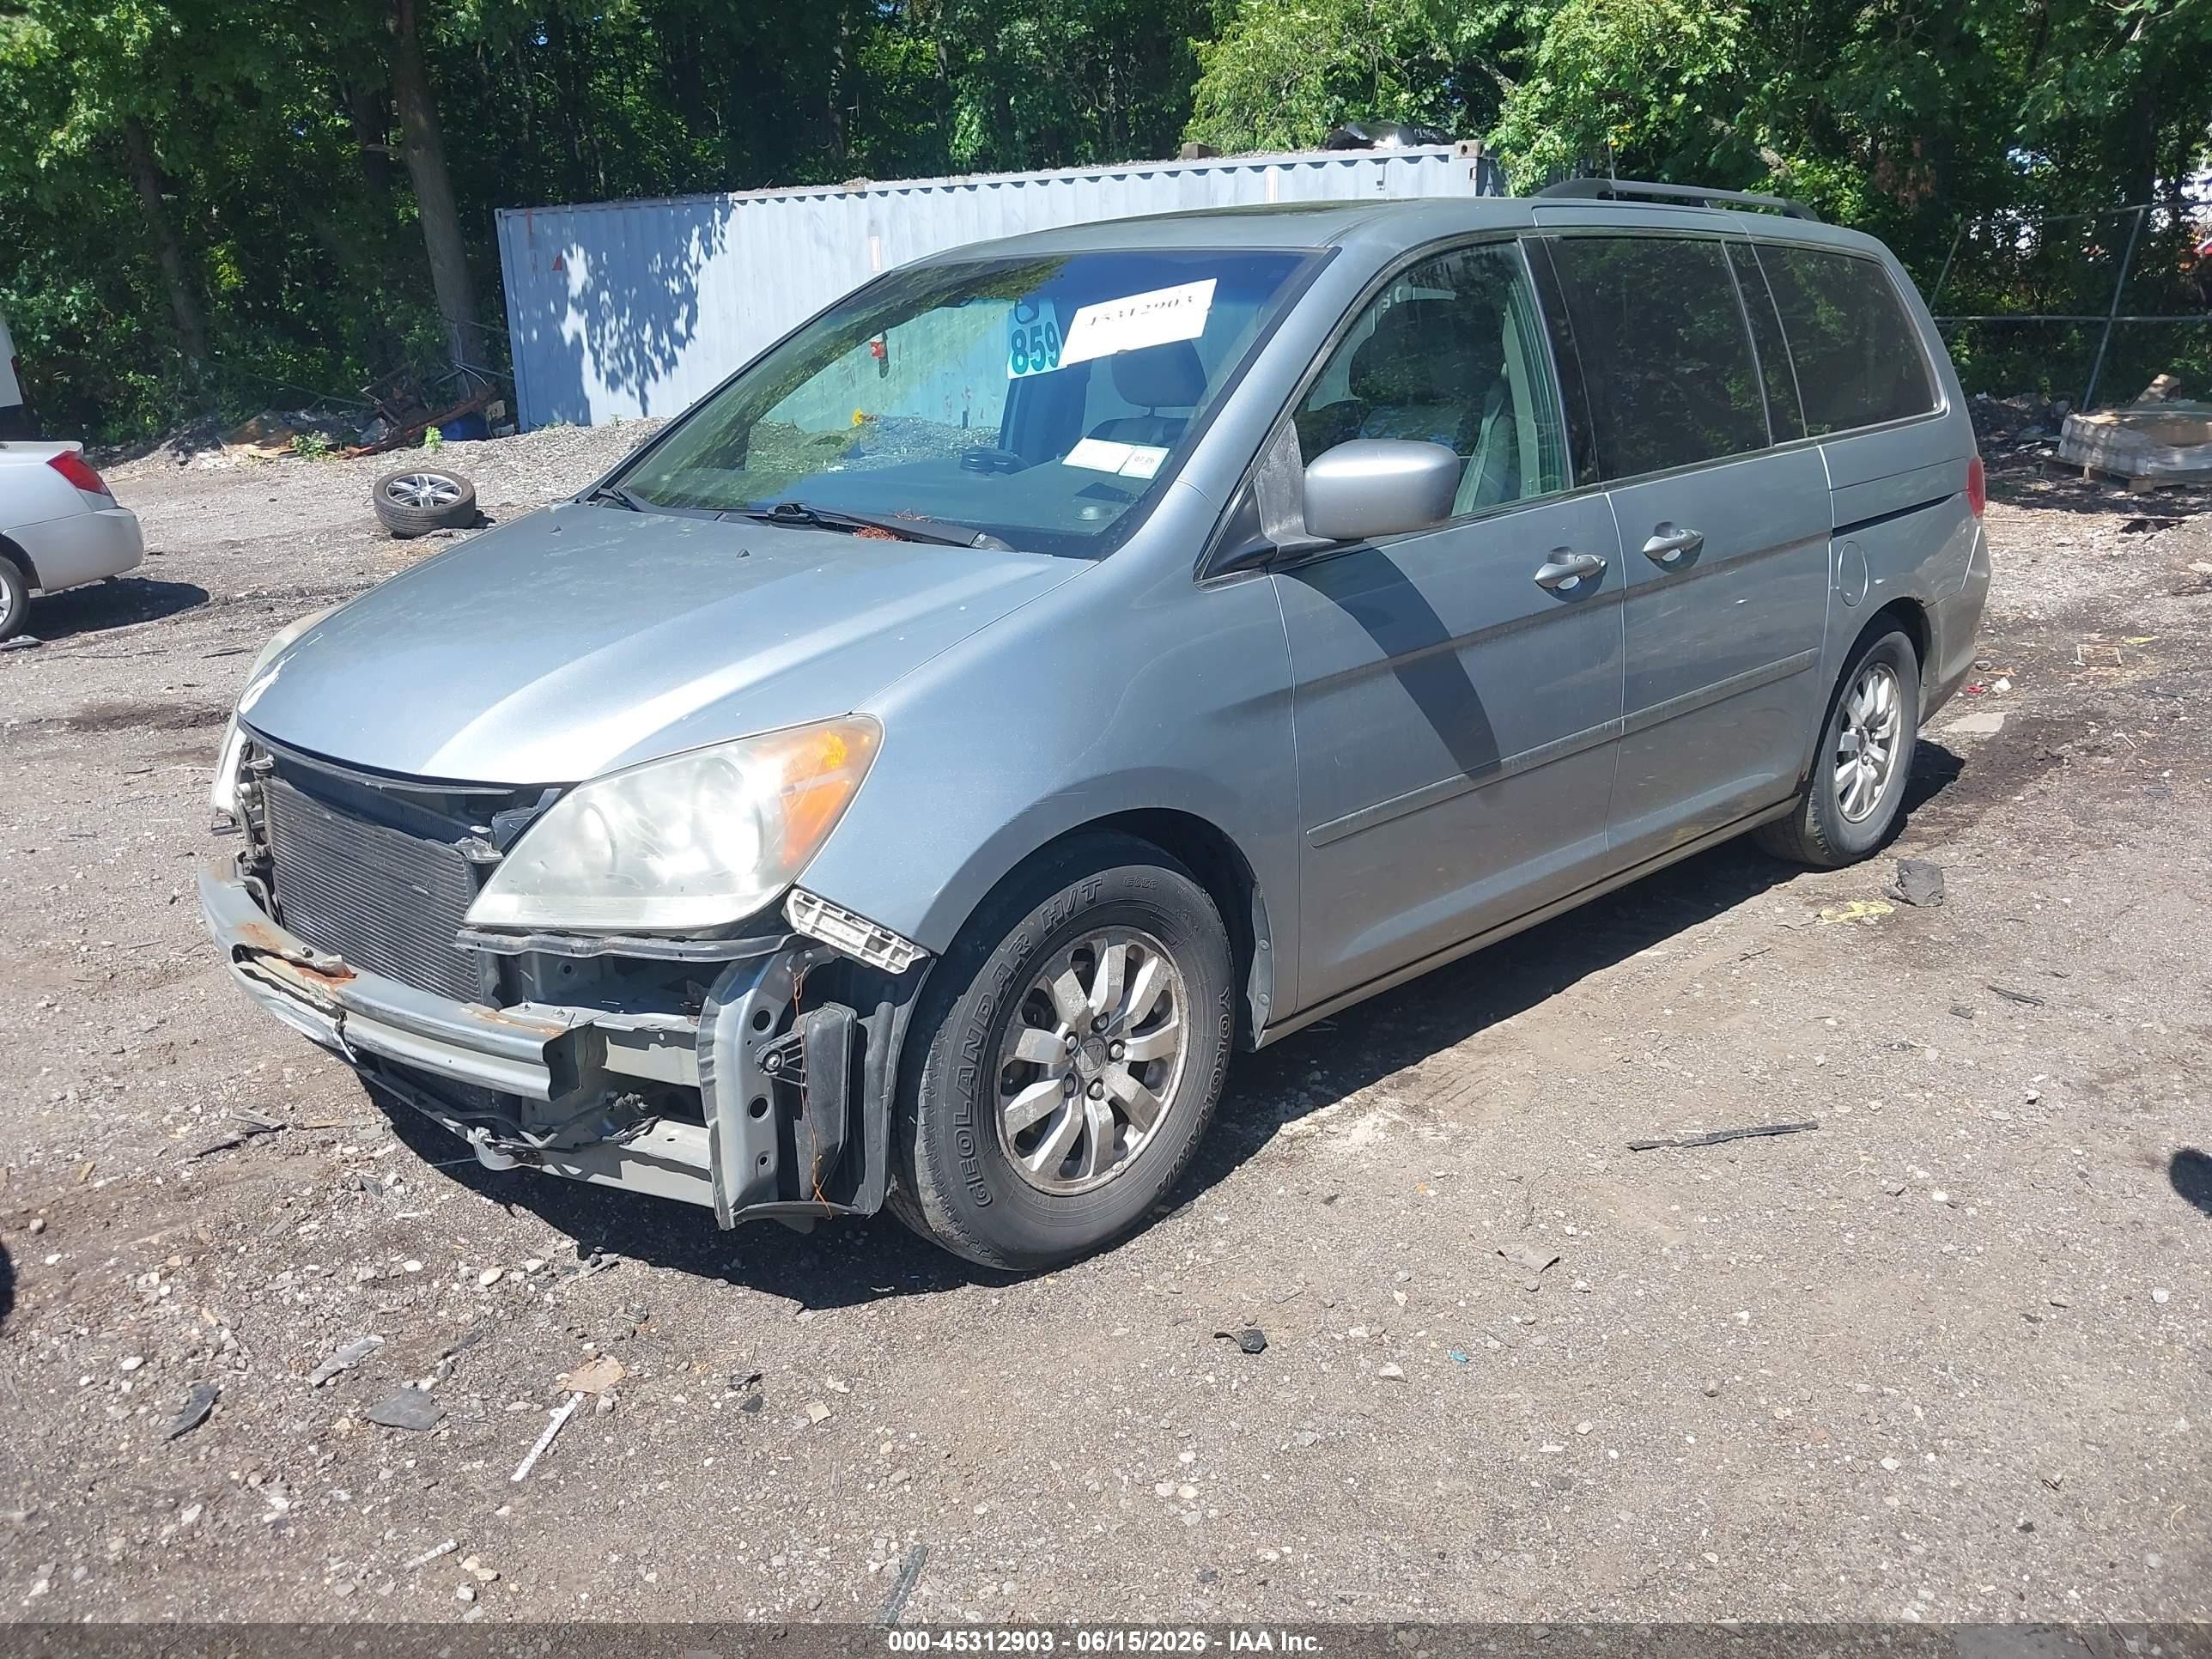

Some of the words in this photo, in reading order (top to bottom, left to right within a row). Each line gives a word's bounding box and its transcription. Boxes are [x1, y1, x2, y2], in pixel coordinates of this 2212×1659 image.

[1011, 321, 1060, 375] 859
[953, 931, 1031, 1207] GEOLANDAR
[1041, 877, 1103, 933] H/T
[1157, 987, 1230, 1196] YOKOHAMA
